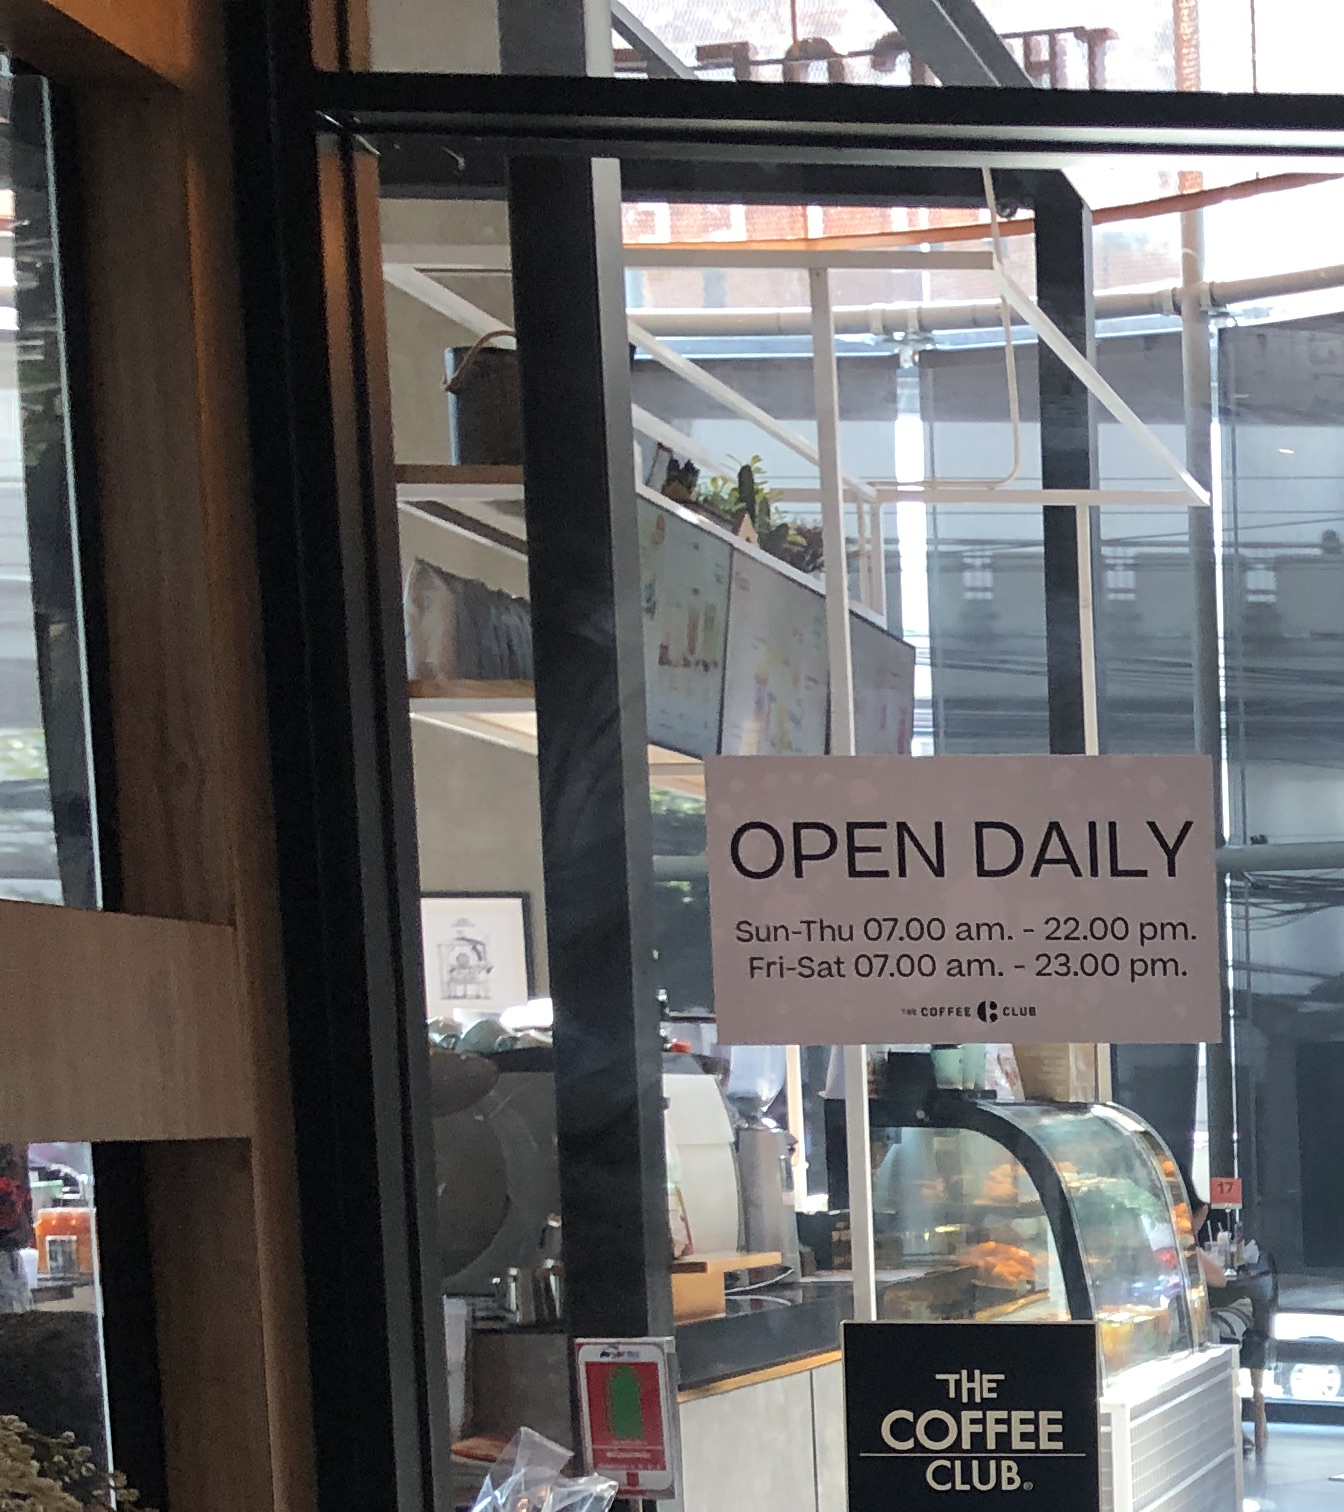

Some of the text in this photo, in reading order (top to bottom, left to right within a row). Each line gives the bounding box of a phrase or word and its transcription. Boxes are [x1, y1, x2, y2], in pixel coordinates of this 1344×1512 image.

[730, 819, 1194, 880] OPEN DAILY
[735, 918, 854, 943] Sun-Thu
[863, 916, 946, 942] 07.00
[955, 921, 1014, 942] am.
[1044, 916, 1129, 942] 22.00
[1139, 921, 1197, 947] pm.
[749, 954, 846, 979] Fri-Sat
[854, 953, 936, 978] 07.00
[945, 958, 1004, 978] am.
[1034, 952, 1120, 978] 23.00
[1130, 957, 1188, 983] pm.
[921, 1006, 972, 1017] COFFEE
[1002, 1006, 1037, 1017] CLUB
[1217, 1181, 1234, 1194] 17
[934, 1368, 1006, 1404] THE
[880, 1409, 1064, 1451] COFFEE
